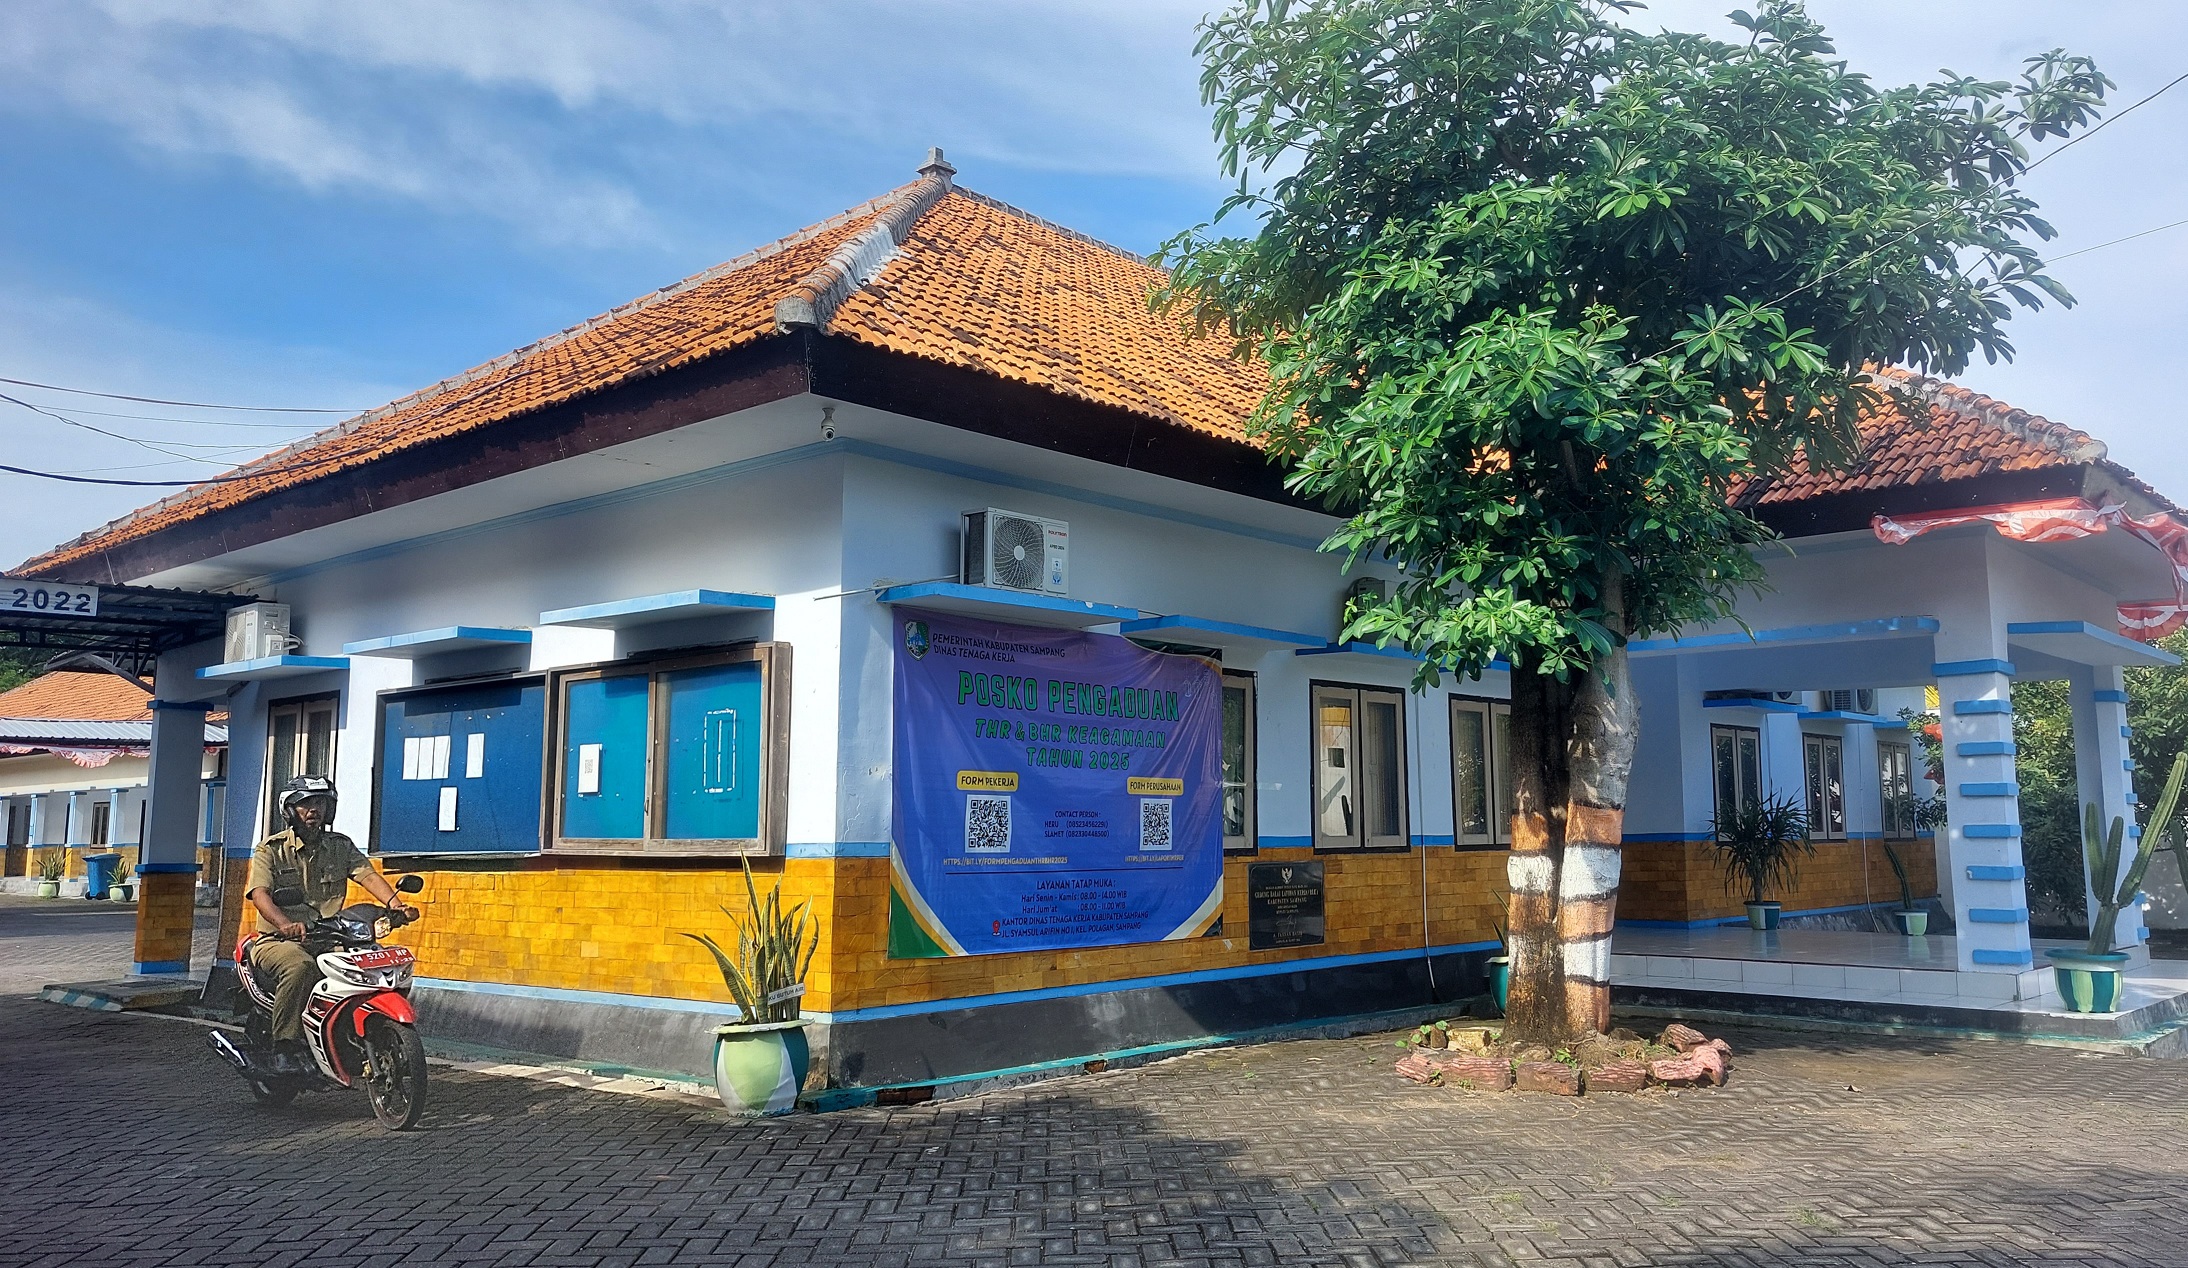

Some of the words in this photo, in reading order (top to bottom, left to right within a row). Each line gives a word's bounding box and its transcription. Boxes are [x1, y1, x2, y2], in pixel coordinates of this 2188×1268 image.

[12, 588, 91, 613] 2022
[932, 633, 983, 648] PEMERINTAH
[985, 640, 1029, 654] KABUPATEN
[1030, 646, 1065, 658] SAMPANG
[934, 644, 956, 656] DINAS
[959, 648, 990, 660] TENAGA
[992, 652, 1016, 663] KERJA
[958, 670, 1038, 711] POSKO
[1047, 680, 1180, 722] PENGADUAN
[976, 718, 1011, 739] THR
[1015, 721, 1025, 741] &
[1028, 723, 1062, 742] BHR
[1068, 726, 1166, 748] KEAGAMAAN
[1027, 747, 1083, 768] TAHUN
[1090, 752, 1129, 770] 2025
[961, 776, 984, 786] FORM
[985, 777, 1015, 787] PEKERJA
[1130, 781, 1146, 790] FORM
[1147, 782, 1181, 791] PERUSAHAAN
[1037, 881, 1070, 890] LAYANAN
[1072, 880, 1092, 888] TATAP
[1080, 892, 1097, 900] 08.00
[1022, 906, 1035, 914] Hari
[1002, 917, 1028, 926] KANTOR
[1029, 916, 1048, 925] DINAS
[1049, 915, 1072, 924] TENAGA
[1073, 914, 1090, 922] KERJA
[1092, 913, 1122, 921] KABUPATEN
[1011, 928, 1039, 937] SYAMSUL
[1040, 927, 1060, 936] ARIFIN
[1116, 922, 1141, 930] SAMPANG
[366, 952, 390, 960] 5201
